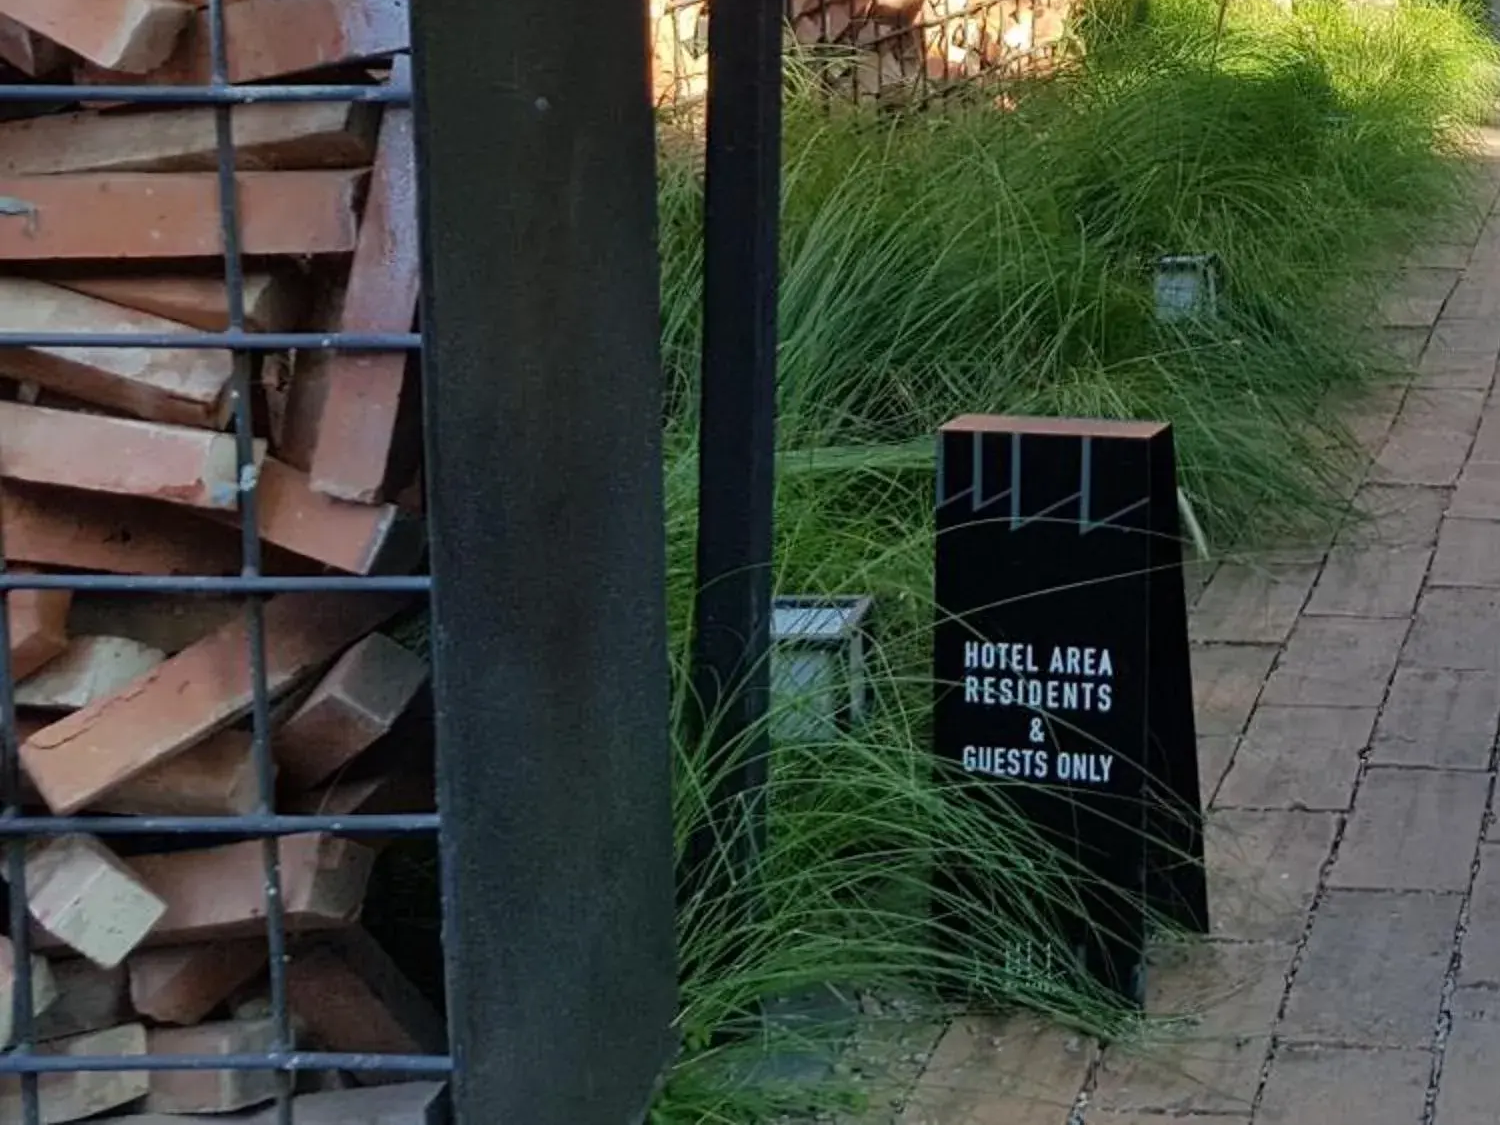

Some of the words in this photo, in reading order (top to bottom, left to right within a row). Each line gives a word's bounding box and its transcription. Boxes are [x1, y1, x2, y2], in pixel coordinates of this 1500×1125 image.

[965, 641, 1038, 672] HOTEL
[1050, 646, 1113, 676] AREA
[965, 676, 1112, 711] RESIDENTS
[1029, 717, 1045, 743] &
[963, 745, 1048, 777] GUESTS
[1057, 752, 1113, 782] ONLY
